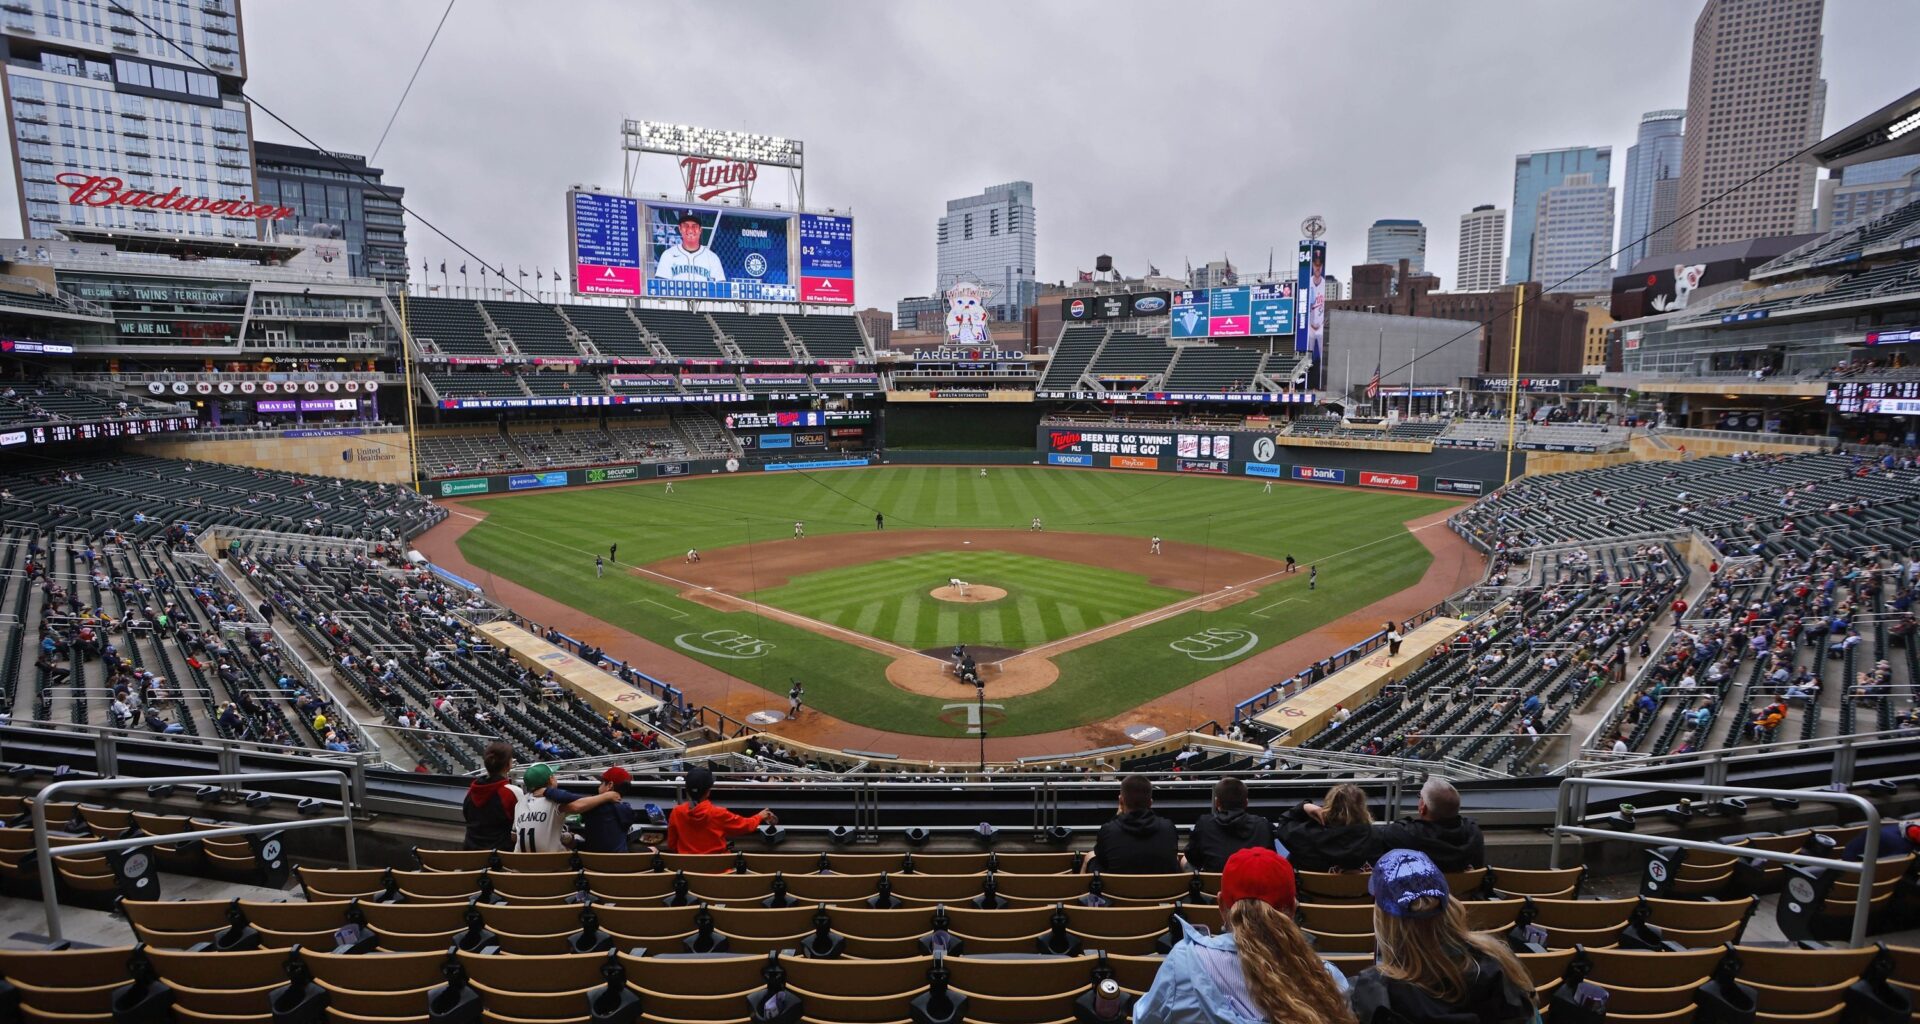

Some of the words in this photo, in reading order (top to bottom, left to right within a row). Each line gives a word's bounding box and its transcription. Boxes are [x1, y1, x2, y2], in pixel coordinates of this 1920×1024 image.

[681, 156, 757, 196] Twins
[56, 172, 296, 219] Budweiser
[742, 229, 767, 238] DONOVAN
[738, 237, 772, 249] SOLANO
[803, 246, 814, 255] 0-2
[1299, 251, 1310, 262] 54
[81, 288, 113, 296] WELCOME
[134, 289, 168, 300] TWINS
[174, 291, 224, 301] TERRITORY
[1274, 285, 1283, 293] 54
[1140, 300, 1159, 309] Ford
[121, 323, 135, 333] WE
[138, 324, 154, 333] ARE
[156, 324, 171, 334] ALL
[913, 351, 967, 359] TARGET
[982, 351, 1024, 359] FIELD
[777, 412, 800, 424] Twins
[1050, 432, 1080, 448] Twins
[1081, 434, 1103, 442] BEER
[1105, 434, 1119, 443] WE
[1139, 436, 1172, 445] TWINS!
[1092, 443, 1118, 453] BEER
[1121, 444, 1137, 454] WE
[1140, 445, 1160, 455] GO!
[1246, 465, 1278, 474] PROGRESSIVE
[1313, 469, 1335, 478] bank
[701, 630, 776, 656] CHS
[1169, 628, 1244, 653] CHS
[519, 828, 536, 853] 11
